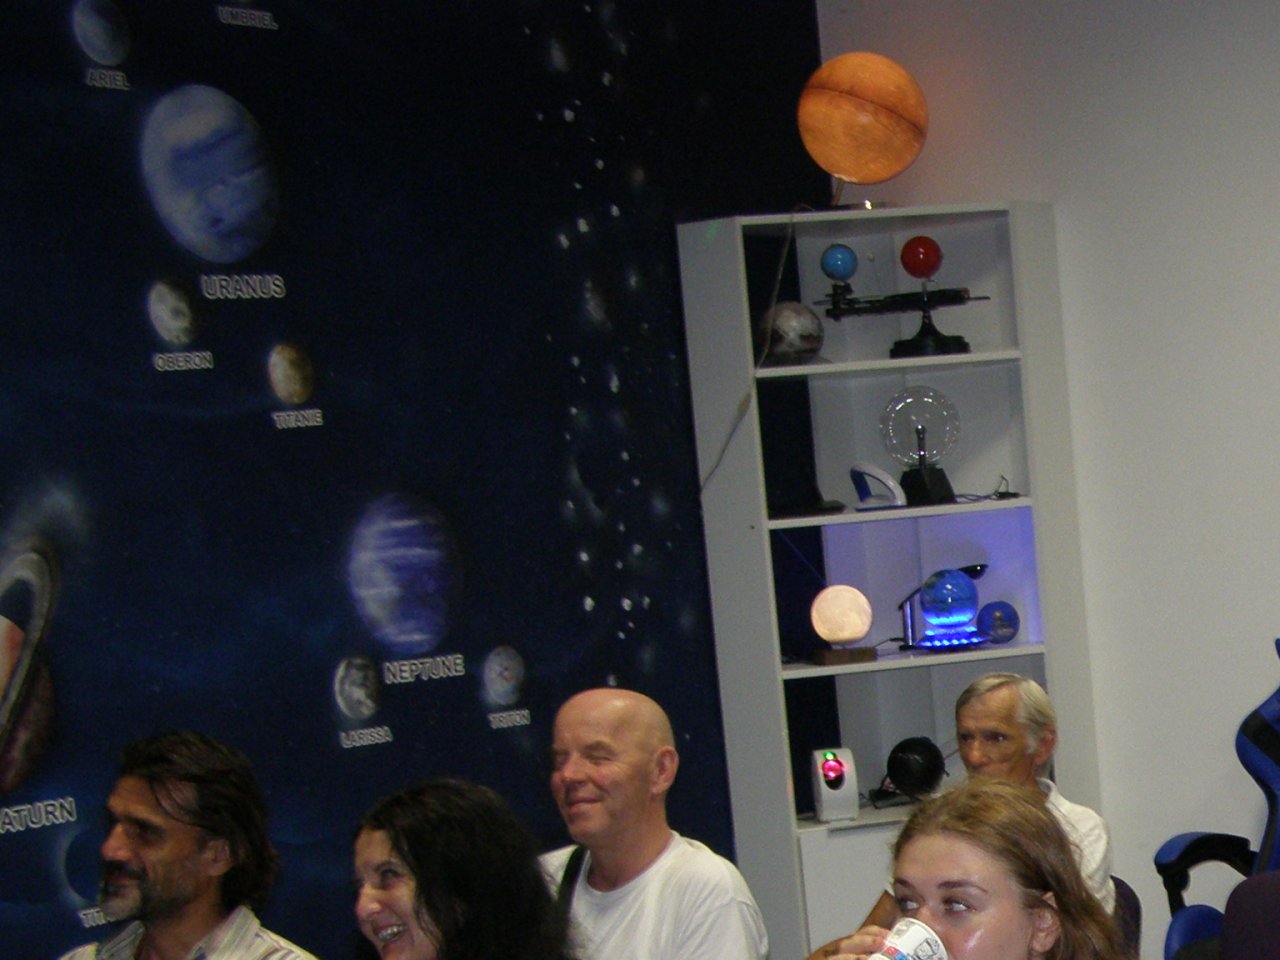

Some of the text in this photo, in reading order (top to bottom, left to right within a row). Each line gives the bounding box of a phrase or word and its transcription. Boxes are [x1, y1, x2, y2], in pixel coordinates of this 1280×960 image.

[86, 69, 130, 90] ARIEL
[200, 273, 287, 299] URANUS
[153, 350, 214, 371] OBERON
[383, 654, 466, 684] NEPTUNE
[487, 708, 531, 729] TRITON
[340, 725, 394, 748] LARISSA
[0, 796, 77, 834] ATURN
